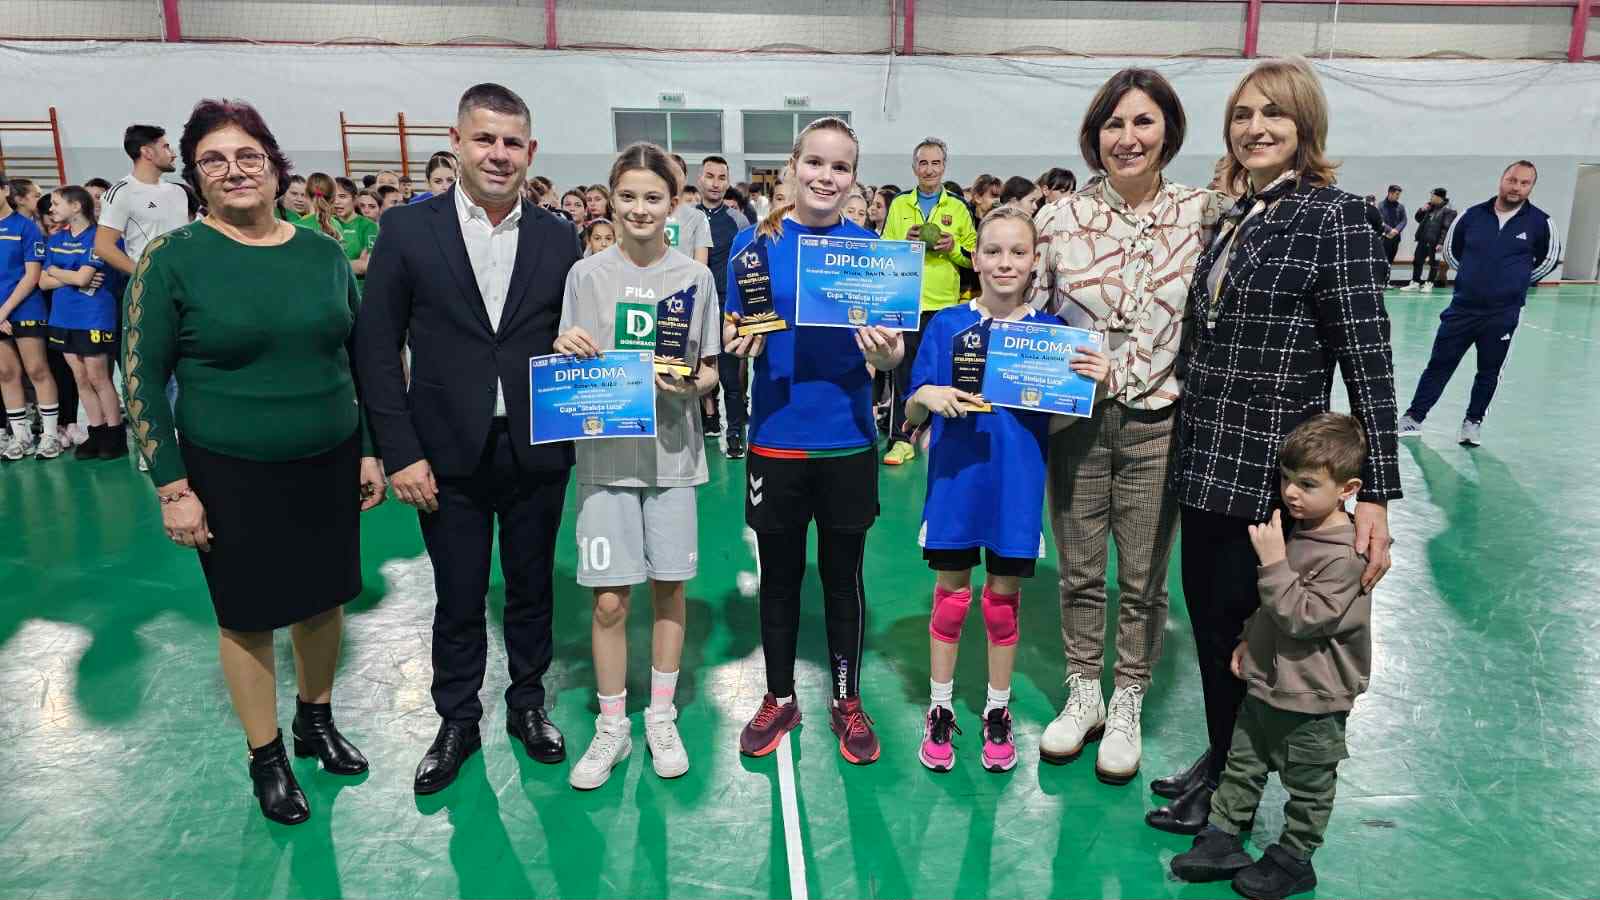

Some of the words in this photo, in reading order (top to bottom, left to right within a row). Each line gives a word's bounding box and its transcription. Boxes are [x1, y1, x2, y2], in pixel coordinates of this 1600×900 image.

[825, 253, 895, 270] DIPLOMA
[625, 286, 655, 298] FILA
[826, 291, 843, 300] Cupa
[626, 309, 653, 337] D
[1004, 336, 1073, 353] DIPLOMA
[555, 367, 626, 382] DIPLOMA
[559, 406, 576, 414] Cupa
[580, 536, 611, 571] 10
